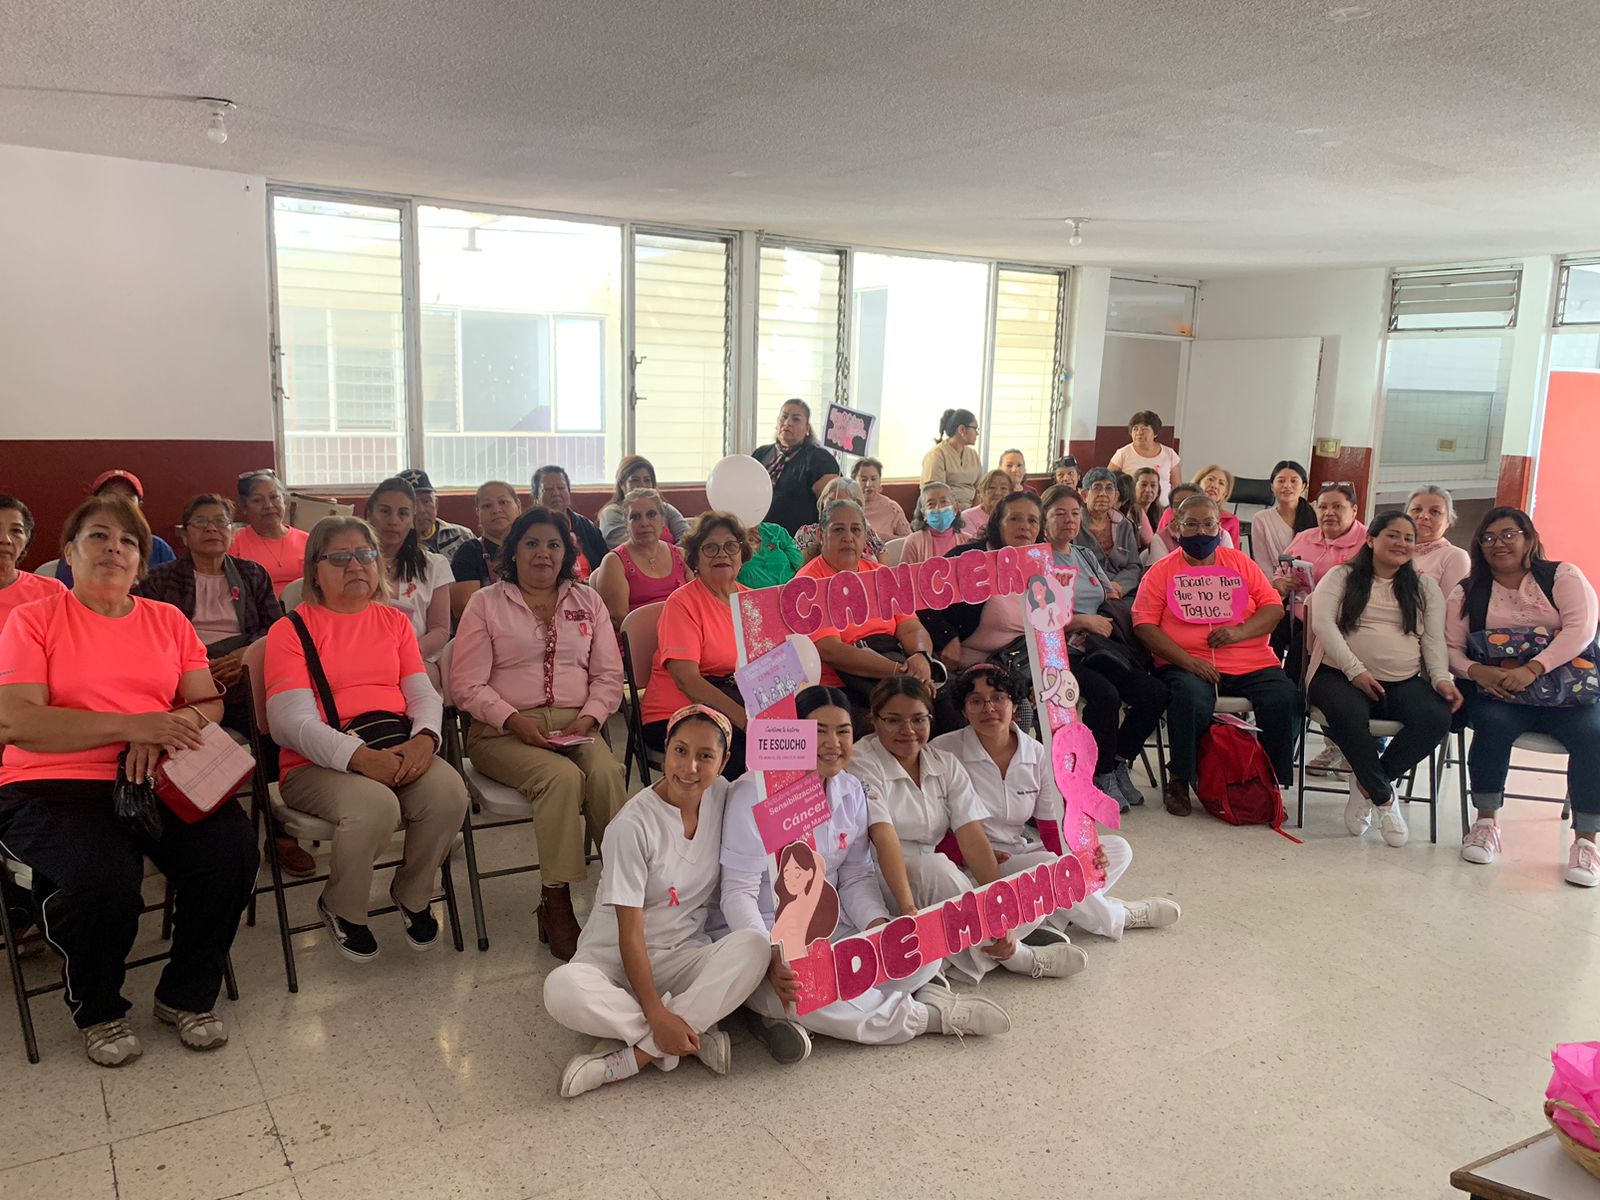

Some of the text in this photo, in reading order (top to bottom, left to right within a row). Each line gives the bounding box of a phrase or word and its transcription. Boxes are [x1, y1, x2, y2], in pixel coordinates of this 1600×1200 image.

[780, 546, 1026, 635] CANCER
[1174, 590, 1193, 601] que
[1198, 591, 1213, 601] no
[758, 738, 807, 750] TE ESCUCHO
[768, 782, 821, 816] Sensibilización
[782, 799, 827, 831] Cáncer
[802, 823, 811, 832] de
[833, 853, 1087, 1001] DE MAMA
